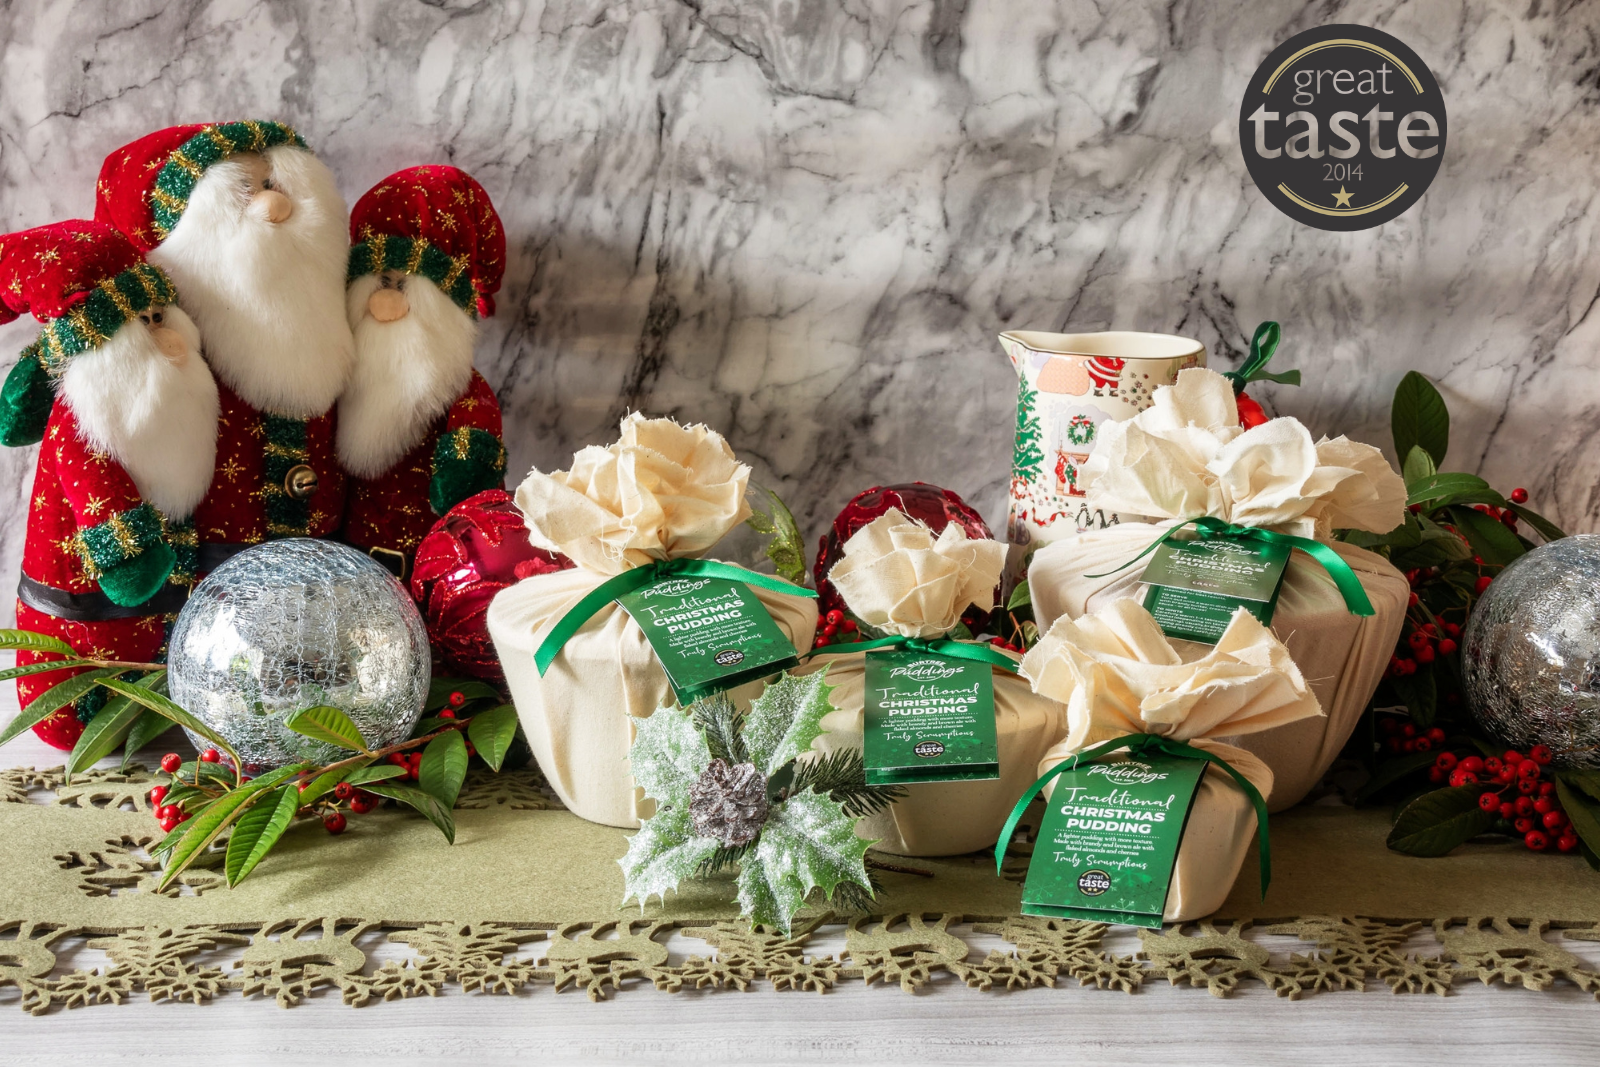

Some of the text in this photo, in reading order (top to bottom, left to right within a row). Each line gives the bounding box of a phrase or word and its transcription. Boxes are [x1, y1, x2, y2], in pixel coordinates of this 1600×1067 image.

[1168, 555, 1265, 572] CHRISTMAS
[1176, 560, 1254, 575] PUDDING
[640, 578, 711, 600] Puddings
[640, 587, 741, 618] Traditional
[653, 599, 745, 626] CHRISTMAS
[667, 610, 742, 634] PUDDING
[677, 646, 706, 659] Truly
[890, 666, 965, 678] Puddings
[876, 682, 980, 700] Traditional
[878, 696, 978, 708] CHRISTMAS
[888, 706, 968, 716] PUDDING
[883, 732, 912, 742] Truly
[1087, 764, 1169, 784] Puddings
[1065, 787, 1175, 810] Traditional
[1060, 805, 1166, 822] CHRISTMAS
[1066, 818, 1152, 834] PUDDING
[1081, 834, 1103, 842] pudding
[1053, 851, 1082, 868] Truly
[1079, 878, 1109, 888] taste
